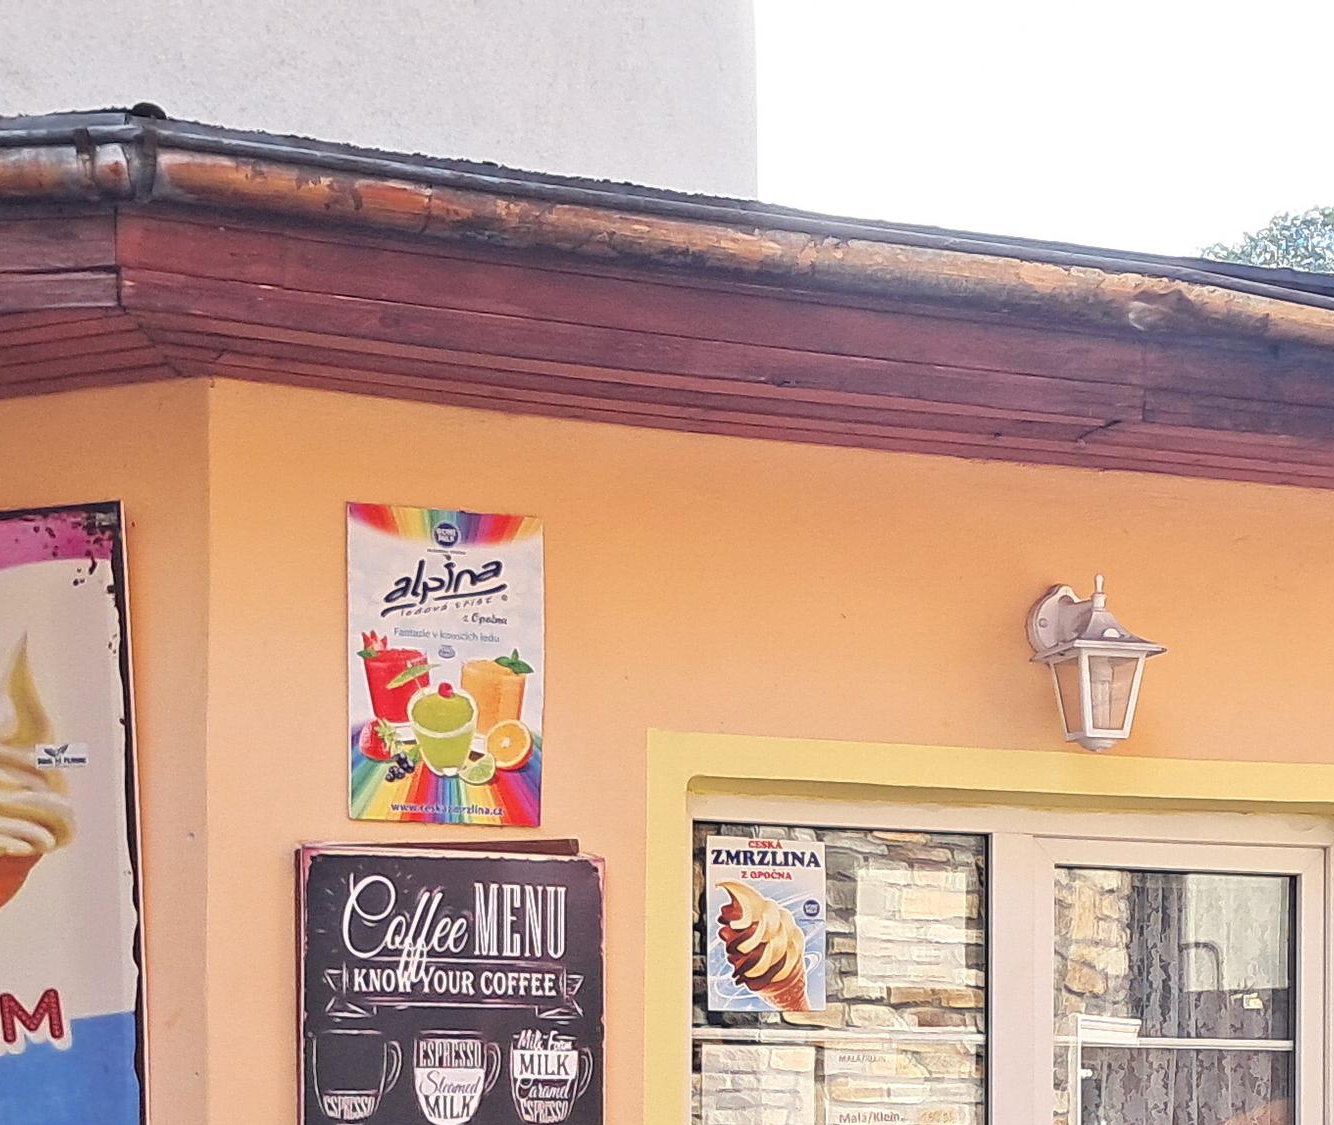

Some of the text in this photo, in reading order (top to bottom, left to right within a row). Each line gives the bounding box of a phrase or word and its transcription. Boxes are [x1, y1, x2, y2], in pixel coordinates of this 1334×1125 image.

[383, 559, 503, 605] alpina
[711, 849, 822, 868] ZMRZLINA
[741, 869, 792, 881] Z OPOČNA
[342, 872, 567, 983] Coffee MENU
[353, 967, 557, 996] KNOW YOUR COFFEE
[419, 1040, 482, 1068] ESPRESSO
[519, 1053, 570, 1076] MILK
[419, 1069, 481, 1096] Steamed
[323, 1095, 376, 1120] ESPRESSO
[424, 1094, 475, 1120] MILK
[520, 1100, 569, 1123] ESPRESSO
